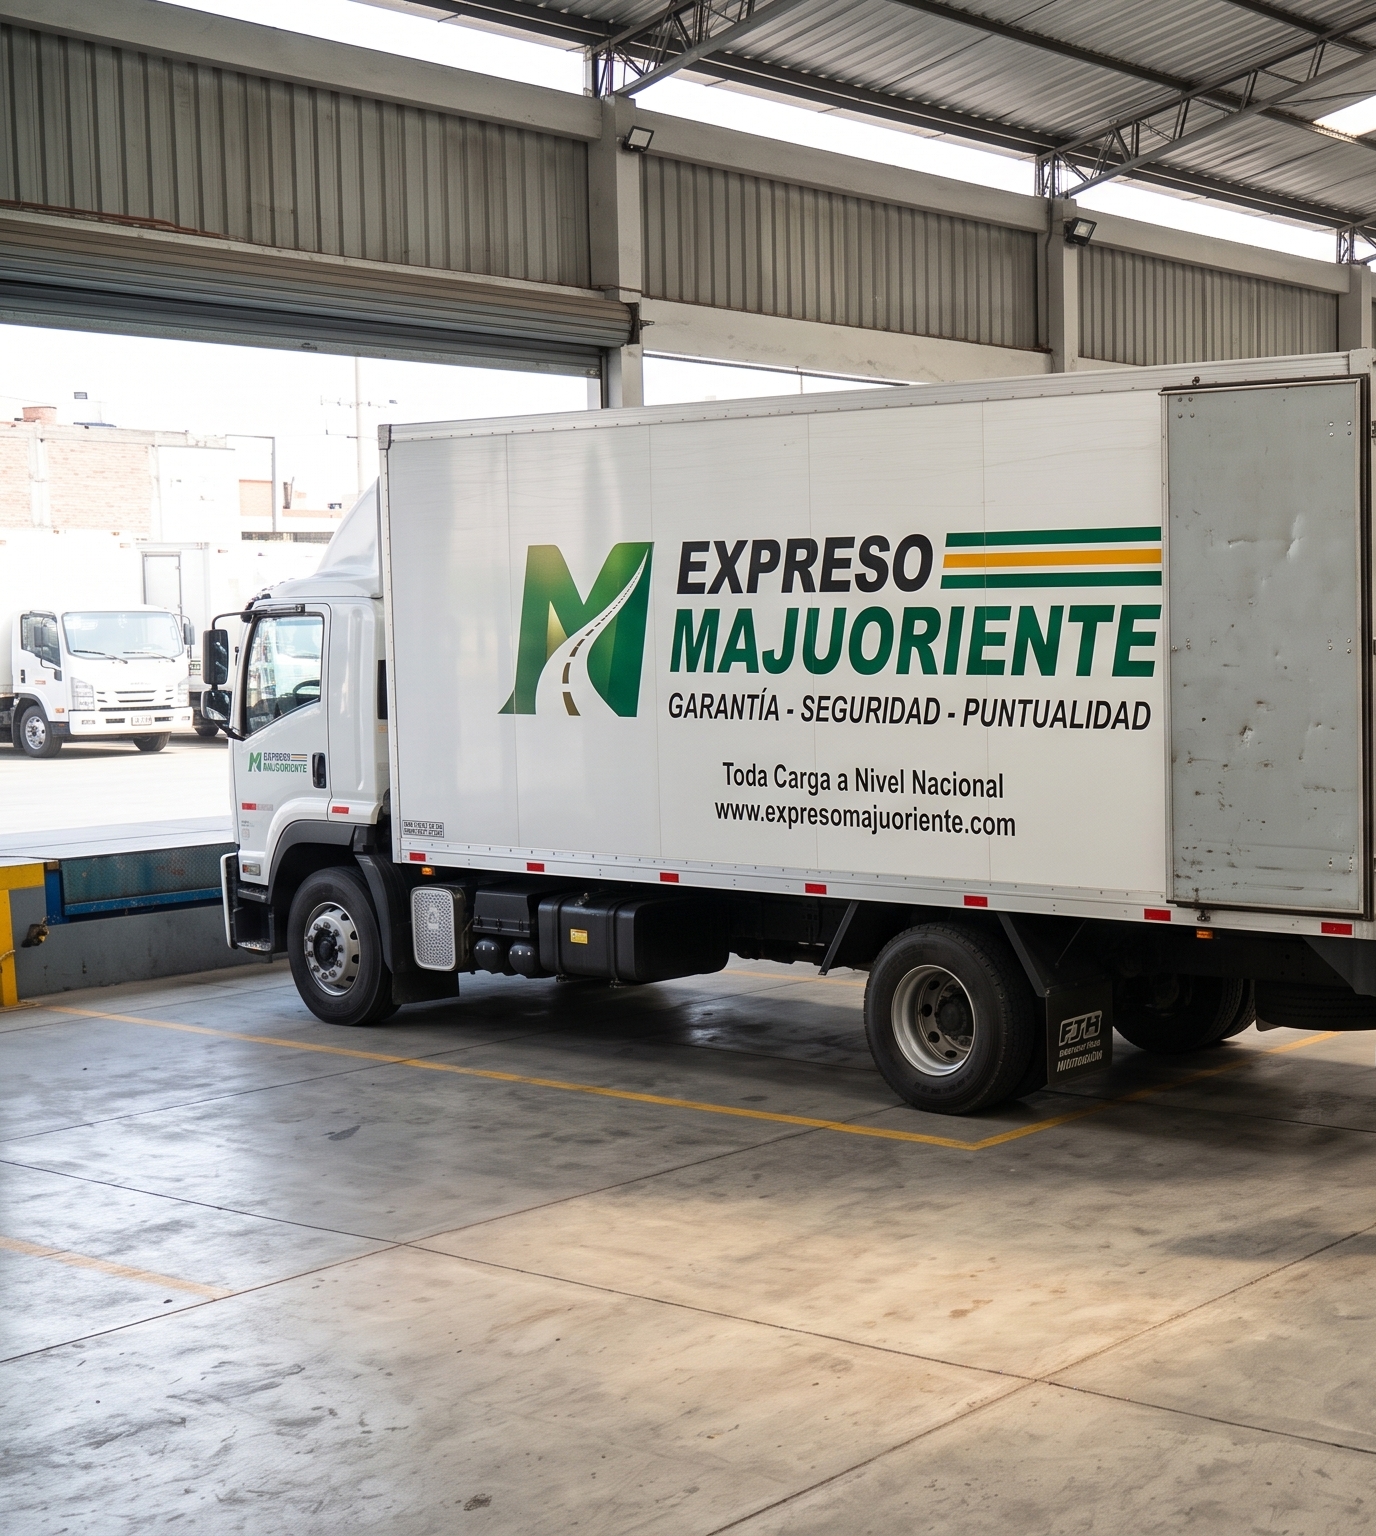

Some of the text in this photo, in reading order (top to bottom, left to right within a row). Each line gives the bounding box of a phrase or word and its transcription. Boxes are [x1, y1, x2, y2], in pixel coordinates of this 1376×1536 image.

[676, 533, 934, 595] EXPRESO
[669, 604, 1162, 677] MAJUORIENTE
[668, 688, 780, 721] GARANTÍA
[801, 695, 941, 725] SEGURIDAD
[963, 697, 1152, 731] PUNTUALIDAD
[722, 762, 1004, 798] Toda Carga a Nivel Nacional
[714, 801, 1016, 837] www.expresomajuoriente.com
